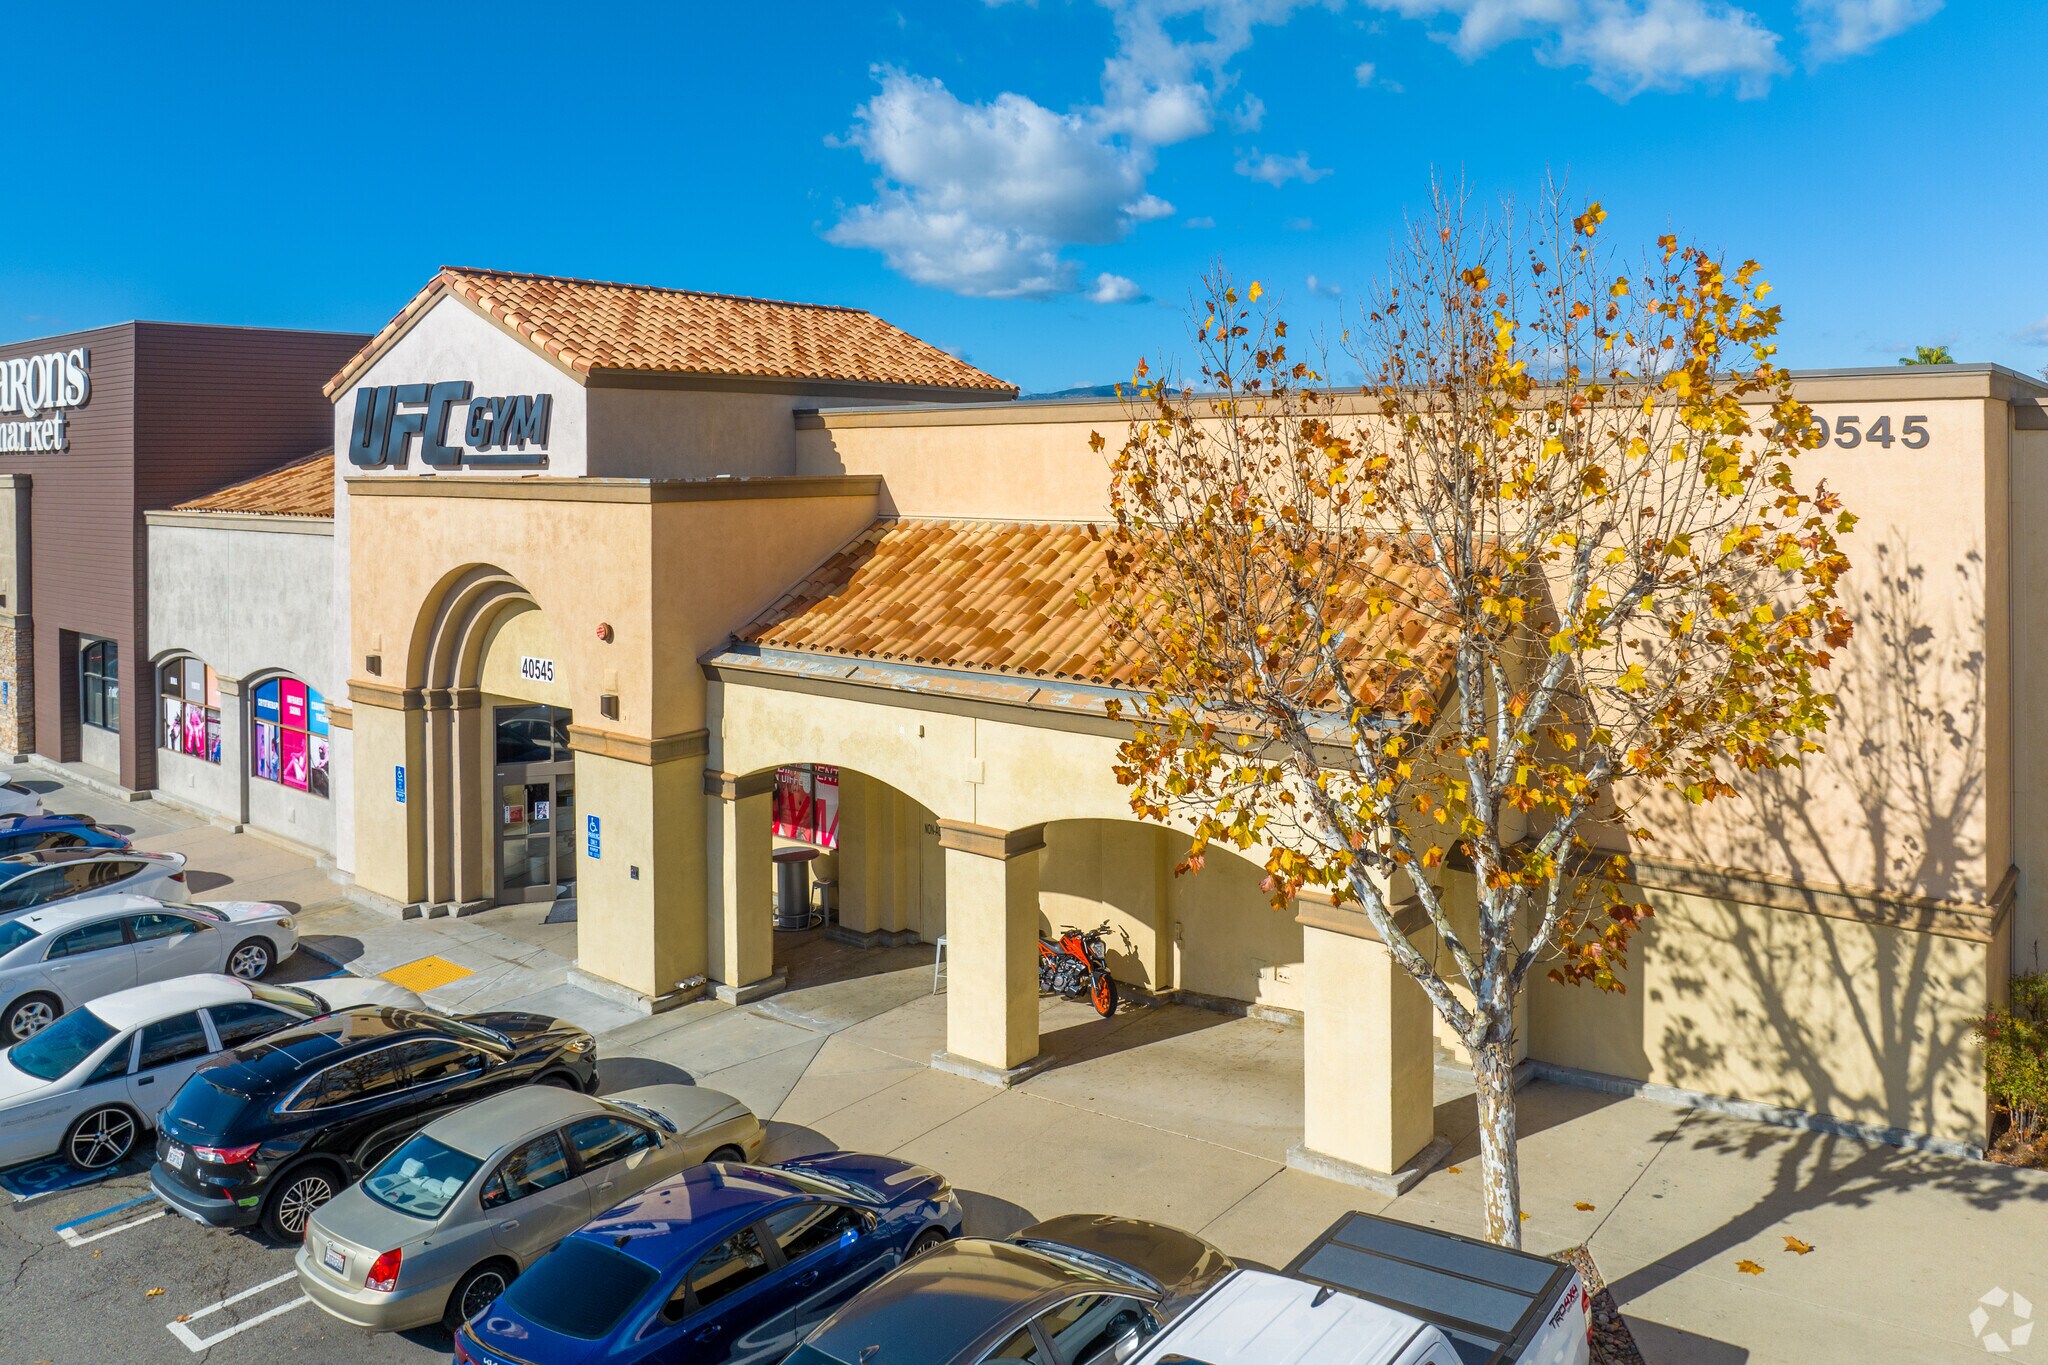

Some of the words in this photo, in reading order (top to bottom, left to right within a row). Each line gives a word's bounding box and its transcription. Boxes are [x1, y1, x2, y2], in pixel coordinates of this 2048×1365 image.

[349, 381, 474, 467] UFC
[465, 394, 553, 451] GYM
[522, 658, 553, 681] 40545
